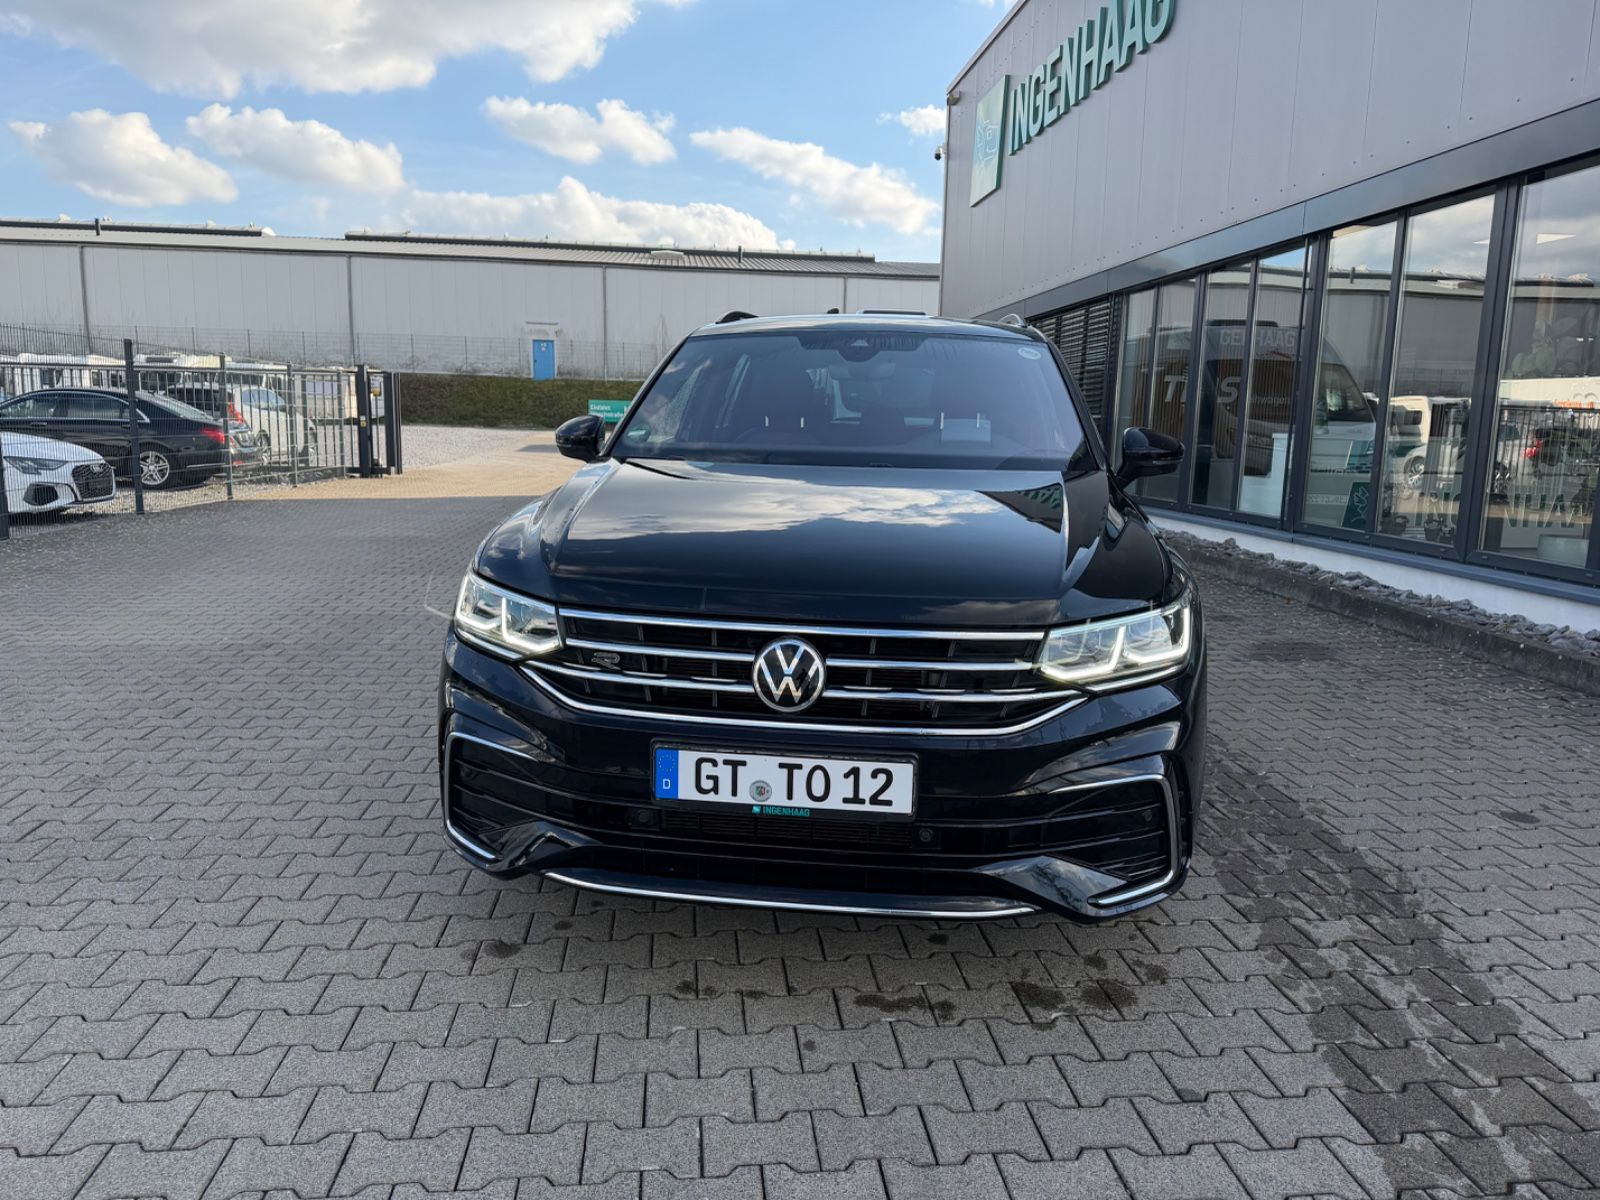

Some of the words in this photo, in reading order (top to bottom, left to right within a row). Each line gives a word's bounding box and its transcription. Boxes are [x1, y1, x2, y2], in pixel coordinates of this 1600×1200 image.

[1008, 0, 1176, 156] INGENHAAG
[662, 778, 671, 790] D
[695, 757, 747, 797] GT
[779, 762, 831, 803] TO
[843, 766, 894, 807] 12
[762, 805, 811, 817] INGENHAAG
